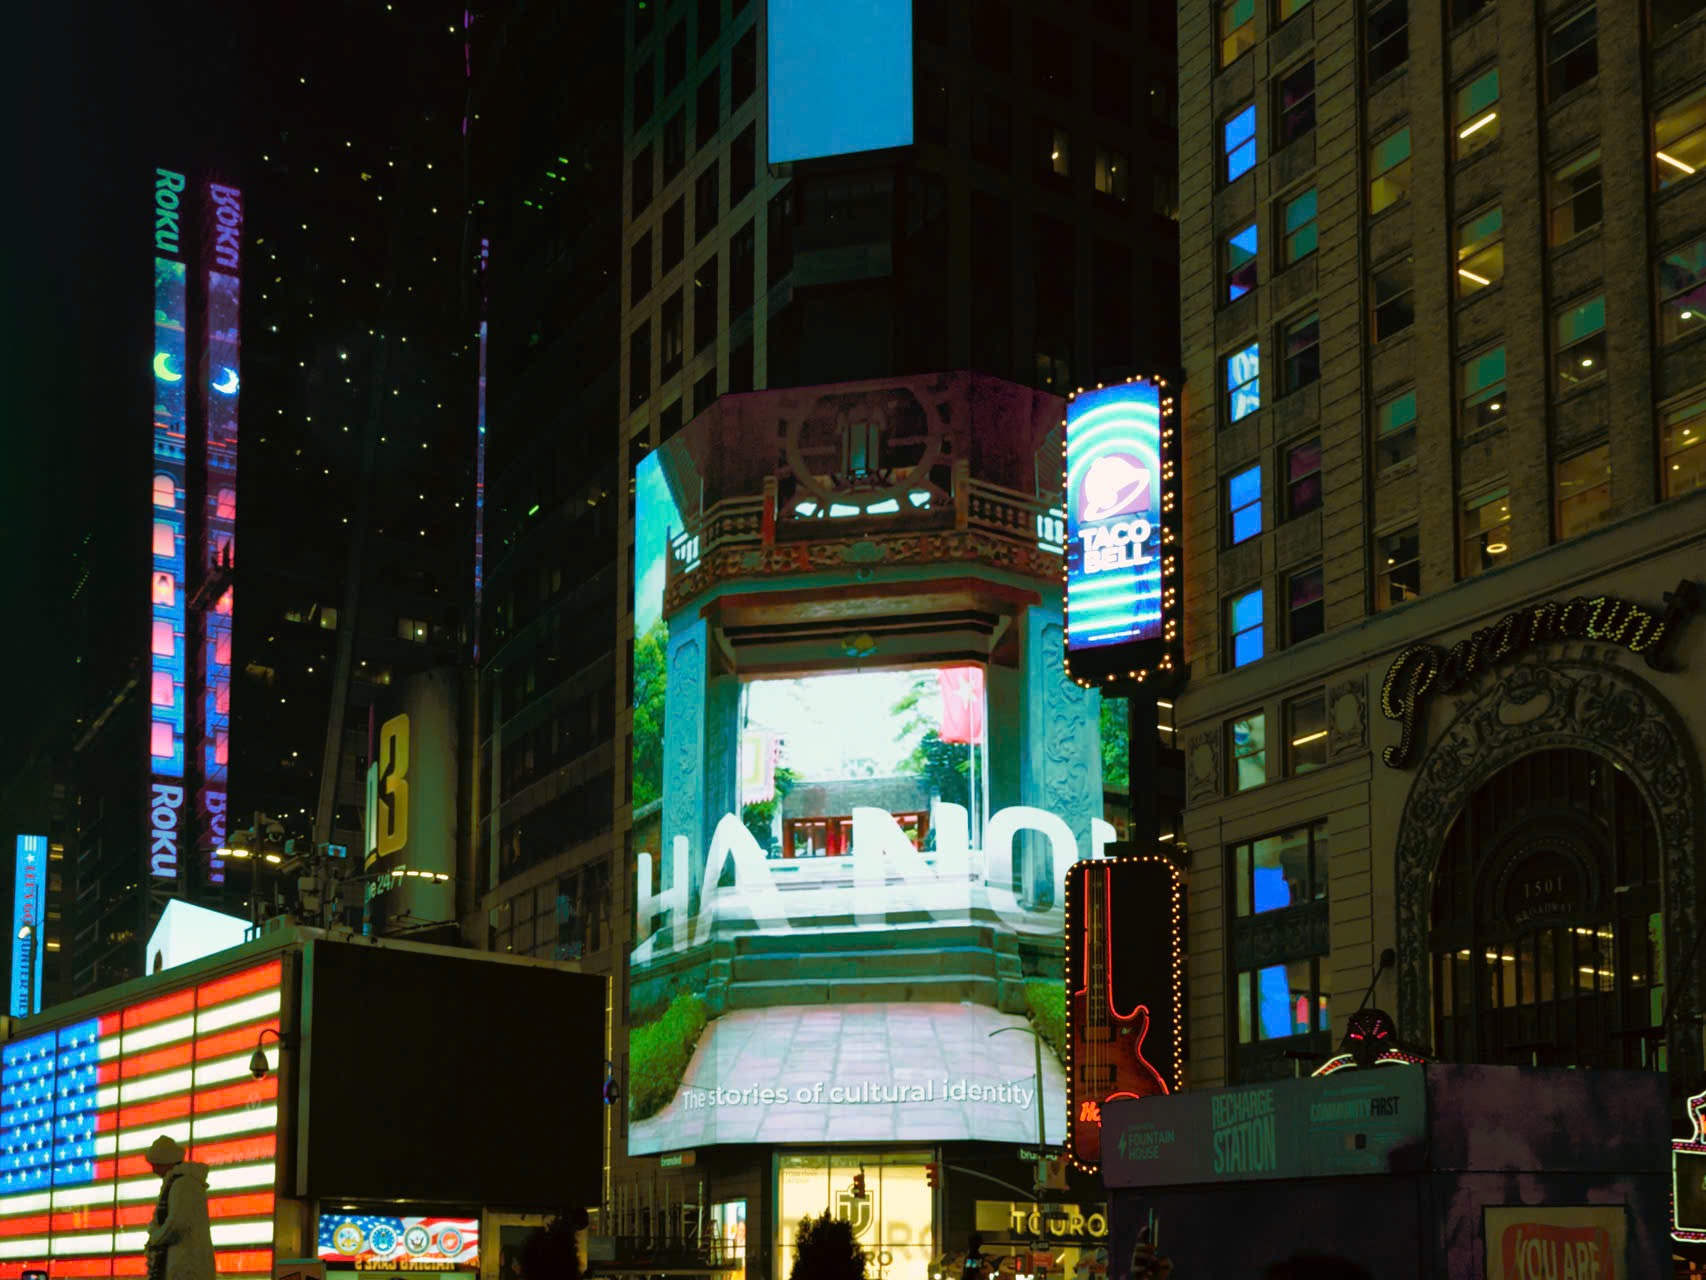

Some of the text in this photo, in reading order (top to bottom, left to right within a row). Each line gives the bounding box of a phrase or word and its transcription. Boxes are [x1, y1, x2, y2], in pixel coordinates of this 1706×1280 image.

[1078, 519, 1152, 553] TACO
[1083, 542, 1153, 575] BELL
[1523, 876, 1563, 899] 1501
[682, 1078, 1036, 1112] The stories of cultural identity
[1211, 1088, 1275, 1130] RECHARGE
[1371, 1096, 1400, 1117] FIRST
[1213, 1112, 1278, 1175] STATION
[1013, 1210, 1107, 1238] TOURO
